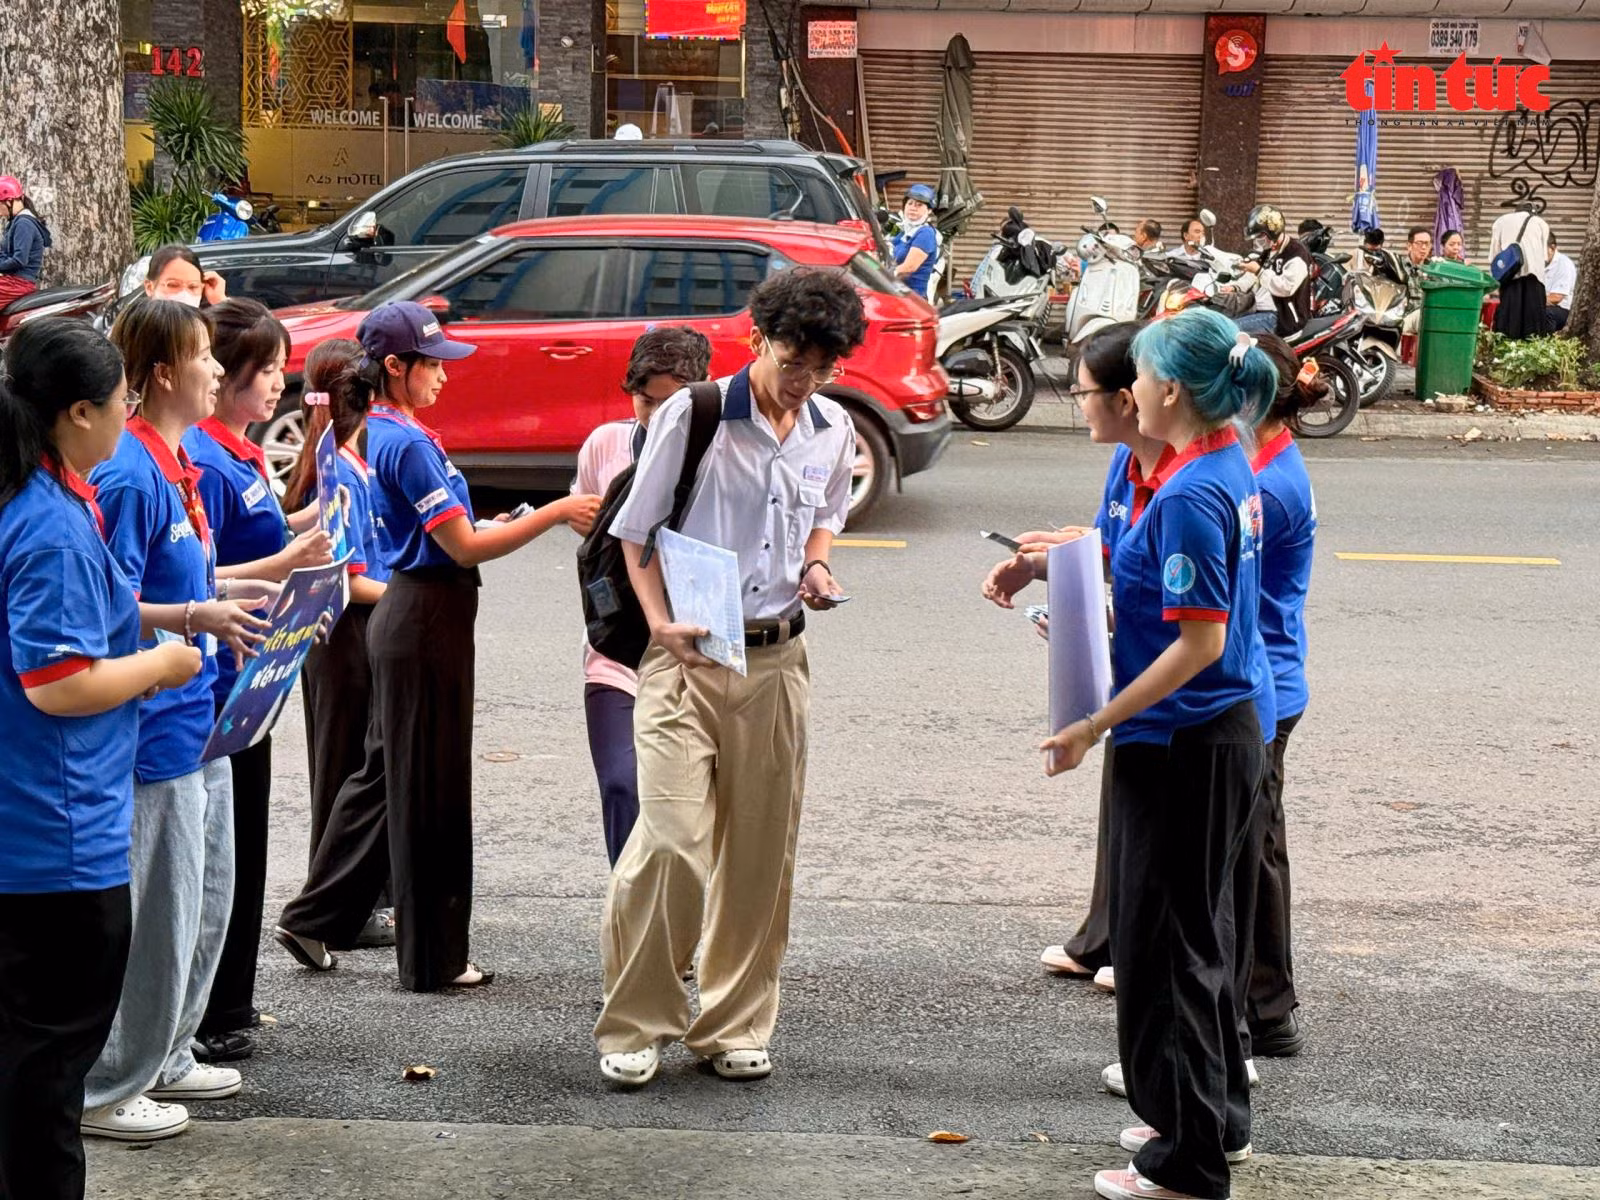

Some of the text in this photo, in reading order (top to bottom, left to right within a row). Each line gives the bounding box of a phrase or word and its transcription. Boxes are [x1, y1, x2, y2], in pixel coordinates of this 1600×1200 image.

[1431, 30, 1448, 47] 0389
[1465, 30, 1478, 47] 179
[151, 46, 204, 77] 142
[310, 109, 381, 126] WELCOME
[413, 112, 483, 129] WELCOME
[337, 173, 383, 187] HOTEL
